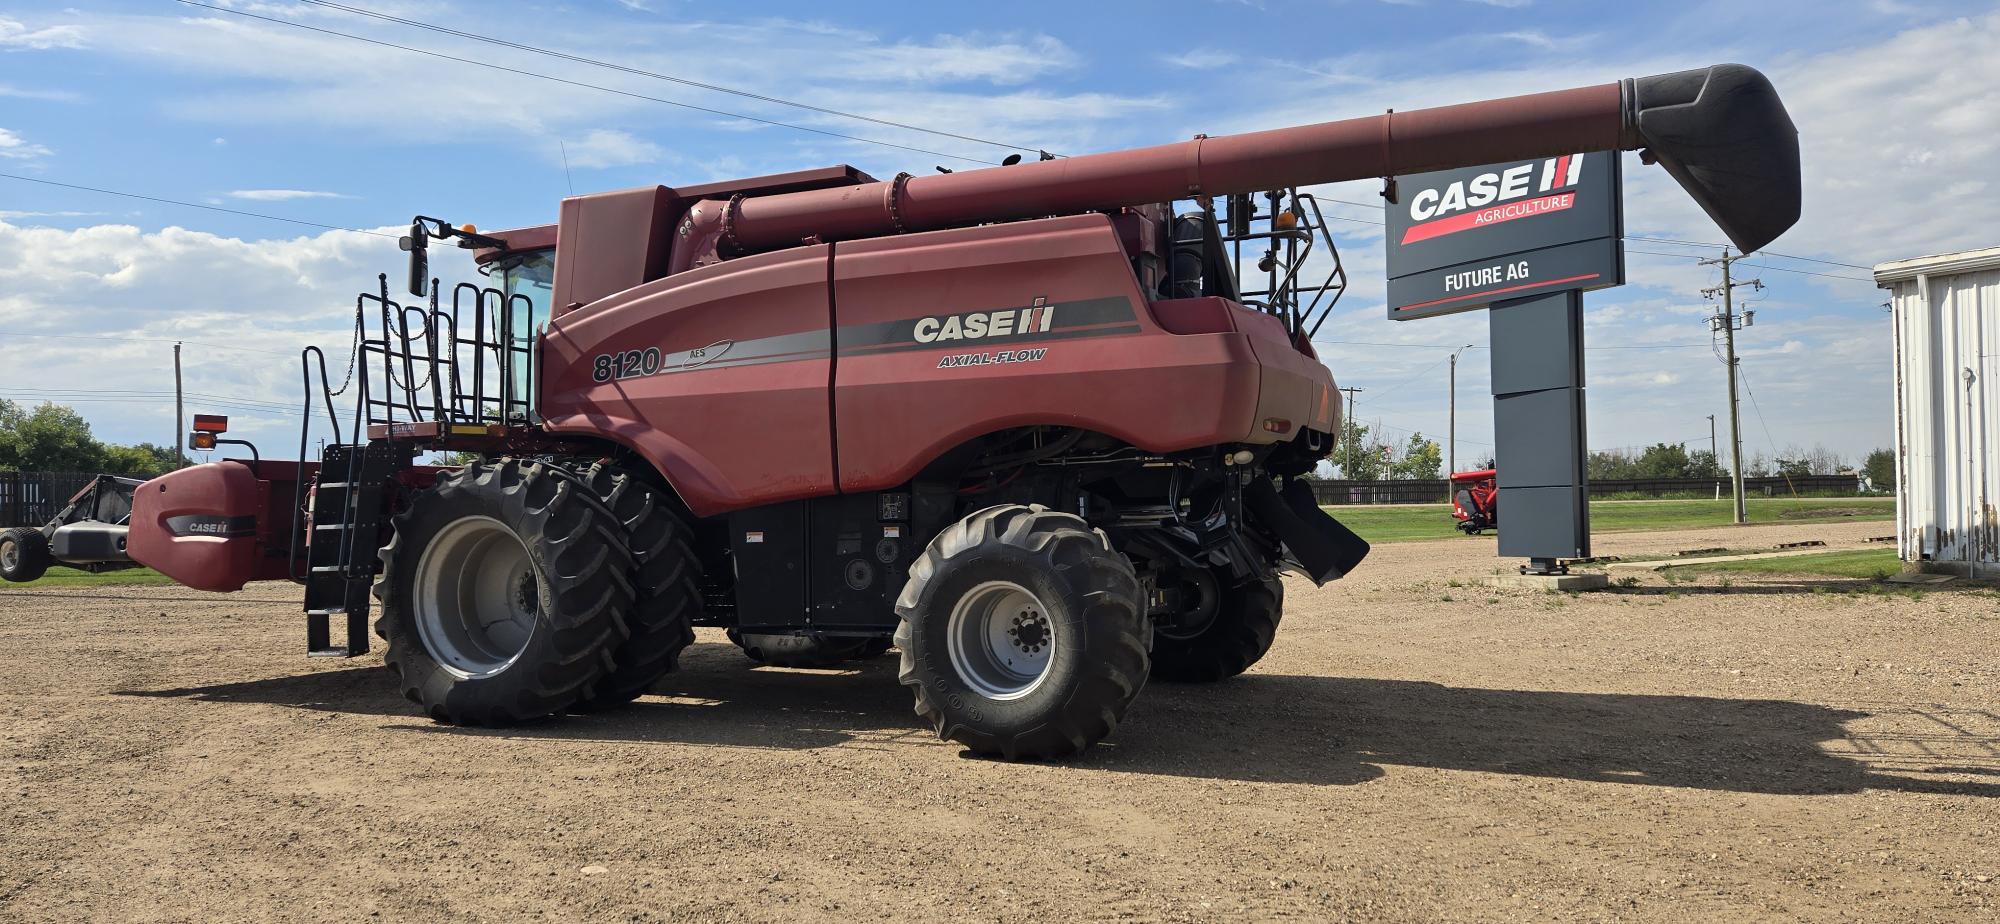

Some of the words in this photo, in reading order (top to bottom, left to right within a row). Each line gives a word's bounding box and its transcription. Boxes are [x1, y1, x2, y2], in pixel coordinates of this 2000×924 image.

[1410, 163, 1534, 221] CASE
[1475, 195, 1569, 224] AGRICULTURE
[1445, 266, 1502, 292] FUTURE
[1506, 261, 1529, 281] AG
[913, 310, 1015, 343] CASE
[593, 346, 661, 382] 8120
[937, 347, 1048, 368] AXIAL-FLOW
[189, 522, 217, 533] CASE
